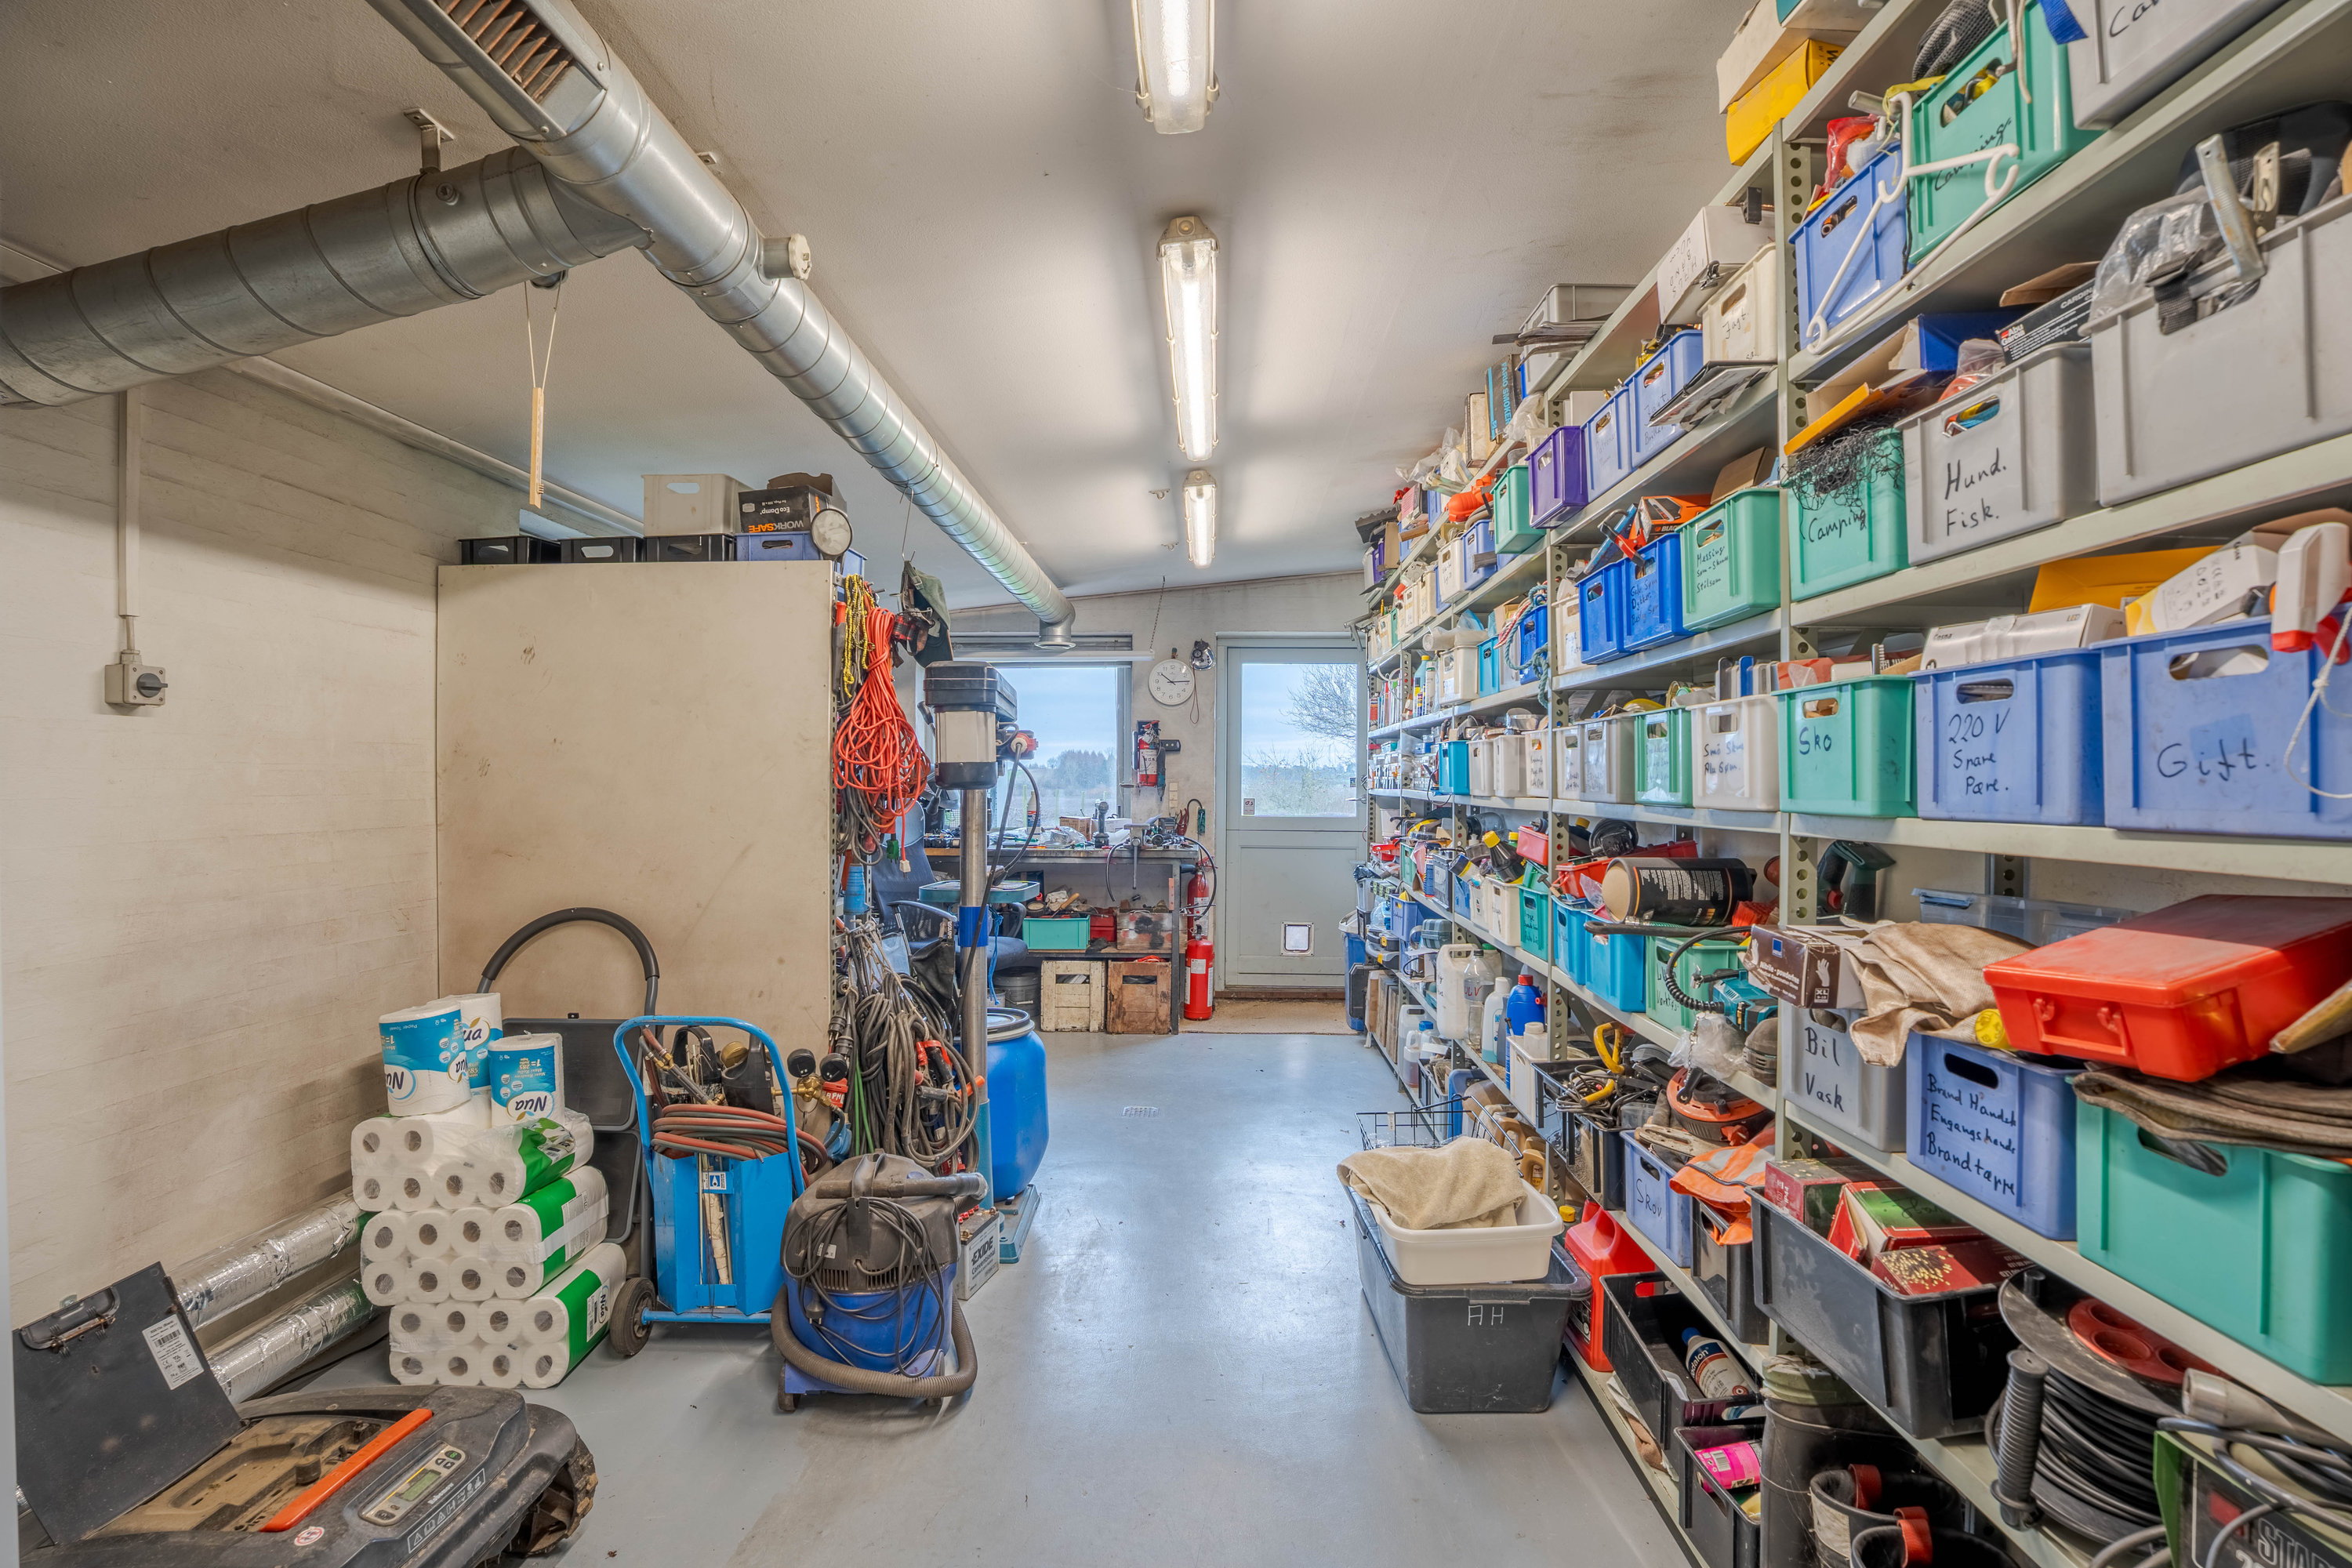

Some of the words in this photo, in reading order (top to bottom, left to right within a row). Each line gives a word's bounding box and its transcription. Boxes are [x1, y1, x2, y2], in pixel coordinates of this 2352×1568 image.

[2109, 0, 2158, 37] Ca
[2060, 286, 2096, 309] CARDIN
[2008, 323, 2024, 336] Abu
[749, 520, 804, 533] WORKSAFE
[1808, 509, 1867, 543] Camping
[1947, 498, 1999, 537] Fisk.
[1799, 726, 1832, 755] Sko
[1948, 713, 1984, 744] 220
[1995, 707, 2011, 734] V
[2157, 737, 2270, 782] Gift.
[463, 1027, 482, 1042] ua
[1804, 1026, 1840, 1067] Bil
[514, 1094, 547, 1112] Nua
[1805, 1072, 1845, 1112] Vask
[971, 1235, 994, 1266] EXIDE
[1690, 1348, 1709, 1379] odalon
